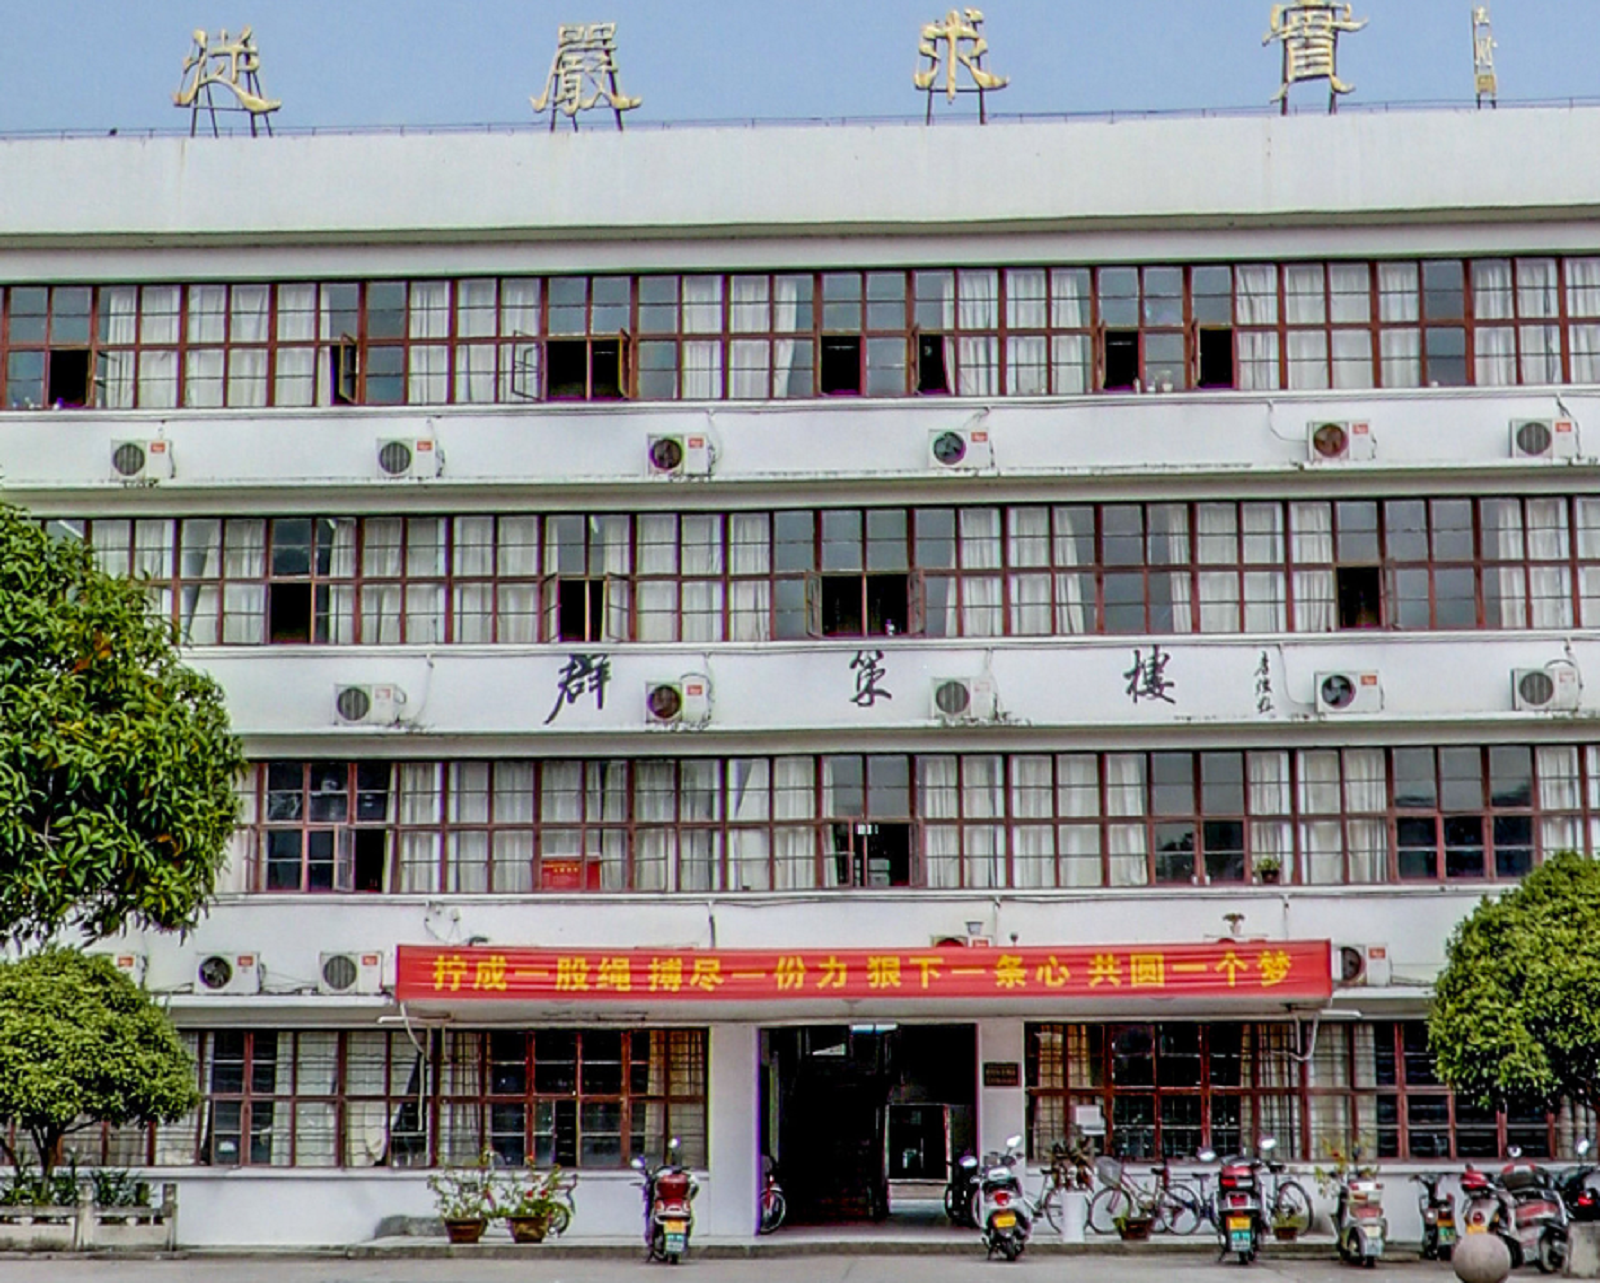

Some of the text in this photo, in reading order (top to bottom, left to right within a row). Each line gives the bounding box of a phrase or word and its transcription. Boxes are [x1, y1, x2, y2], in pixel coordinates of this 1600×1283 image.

[432, 949, 1292, 992] 拧成一股绳 搏尽一份力 狠下一条心 共圆一个梦
